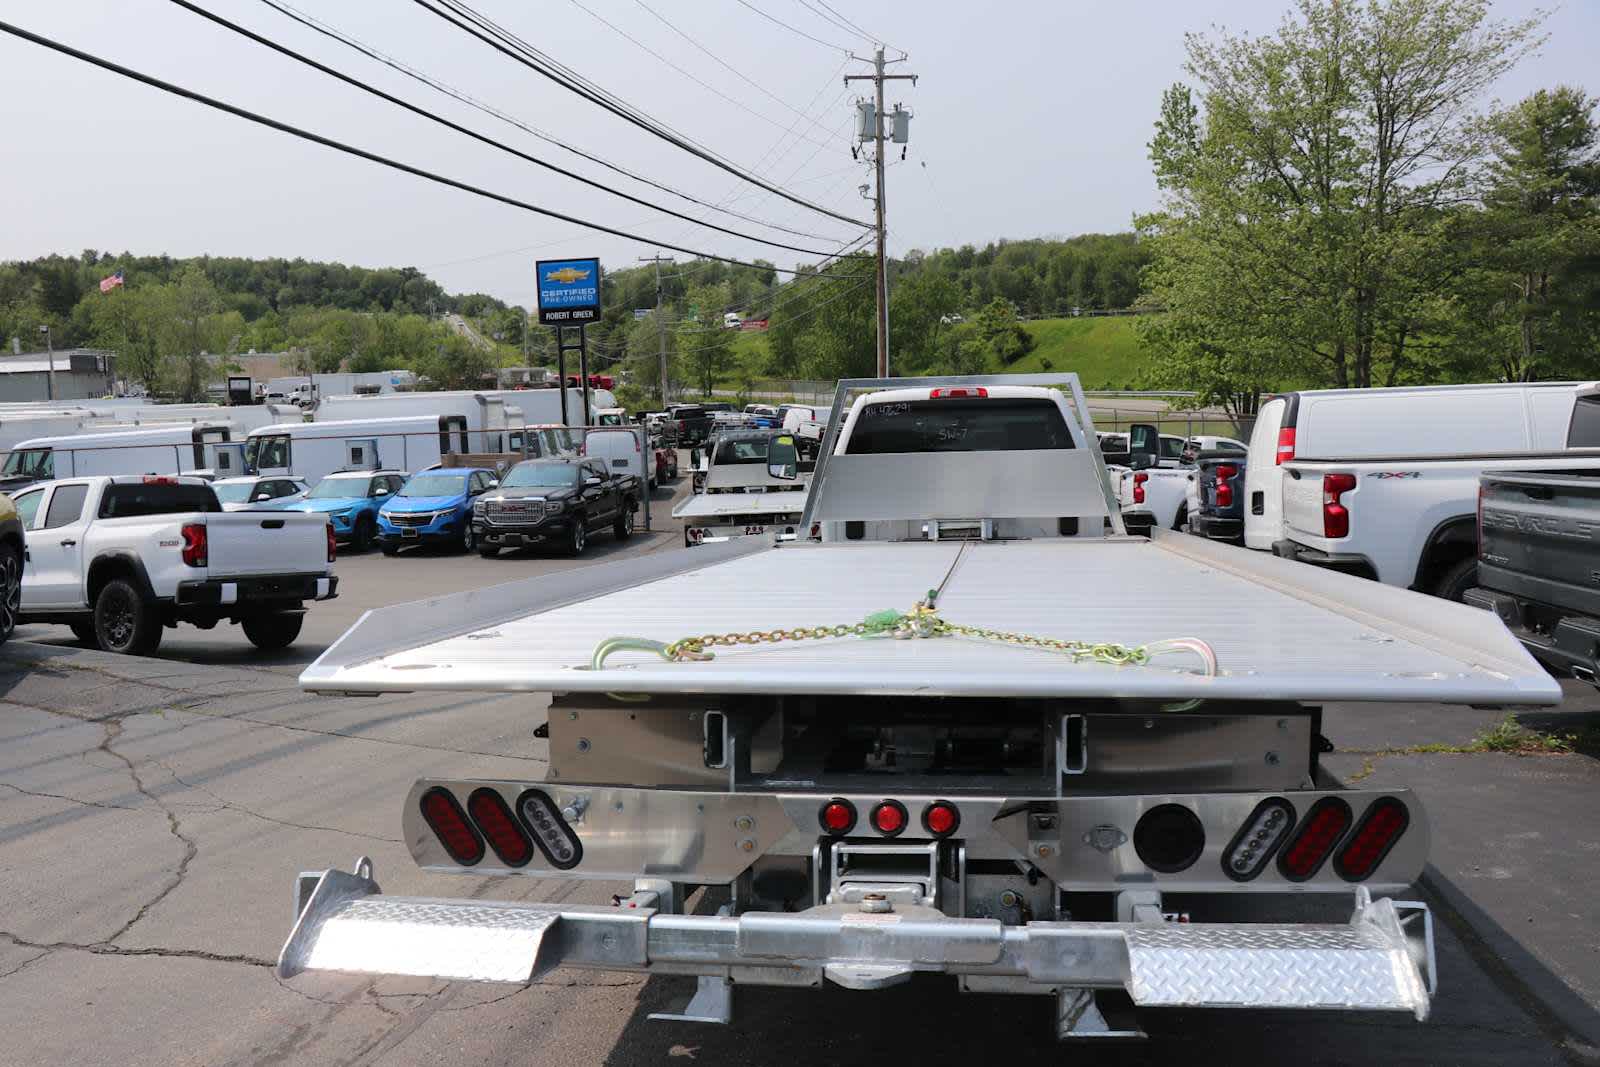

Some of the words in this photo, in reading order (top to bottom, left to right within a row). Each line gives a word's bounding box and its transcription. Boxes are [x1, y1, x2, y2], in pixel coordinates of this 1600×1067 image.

[541, 288, 596, 297] CERTIFIED
[545, 311, 570, 320] ROBERT
[572, 310, 594, 319] GREEN
[1481, 507, 1600, 540] CHEVROLE
